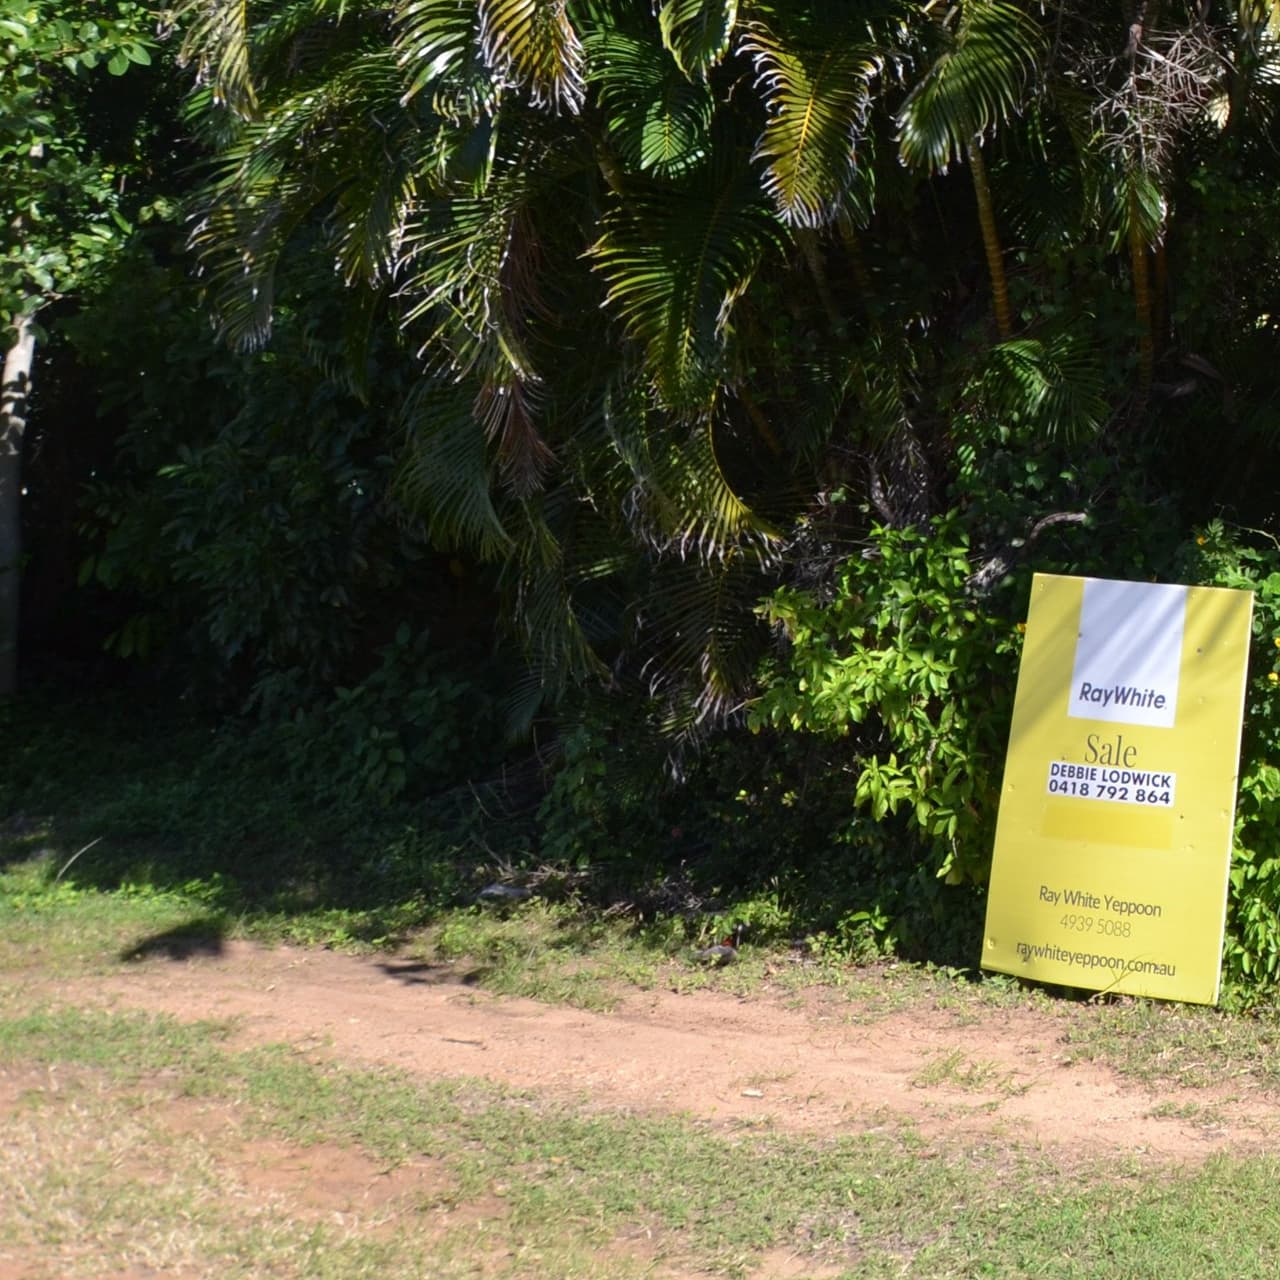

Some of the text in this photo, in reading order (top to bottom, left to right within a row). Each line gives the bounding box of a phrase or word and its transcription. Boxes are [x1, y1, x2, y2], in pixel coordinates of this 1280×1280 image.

[1084, 733, 1138, 768] Sale
[1050, 763, 1171, 788] DEBBIE LODWICK
[1048, 779, 1170, 805] 0418 792 864
[1039, 885, 1162, 917] Ray White Yeppoon
[1060, 914, 1131, 938] 4939 5088
